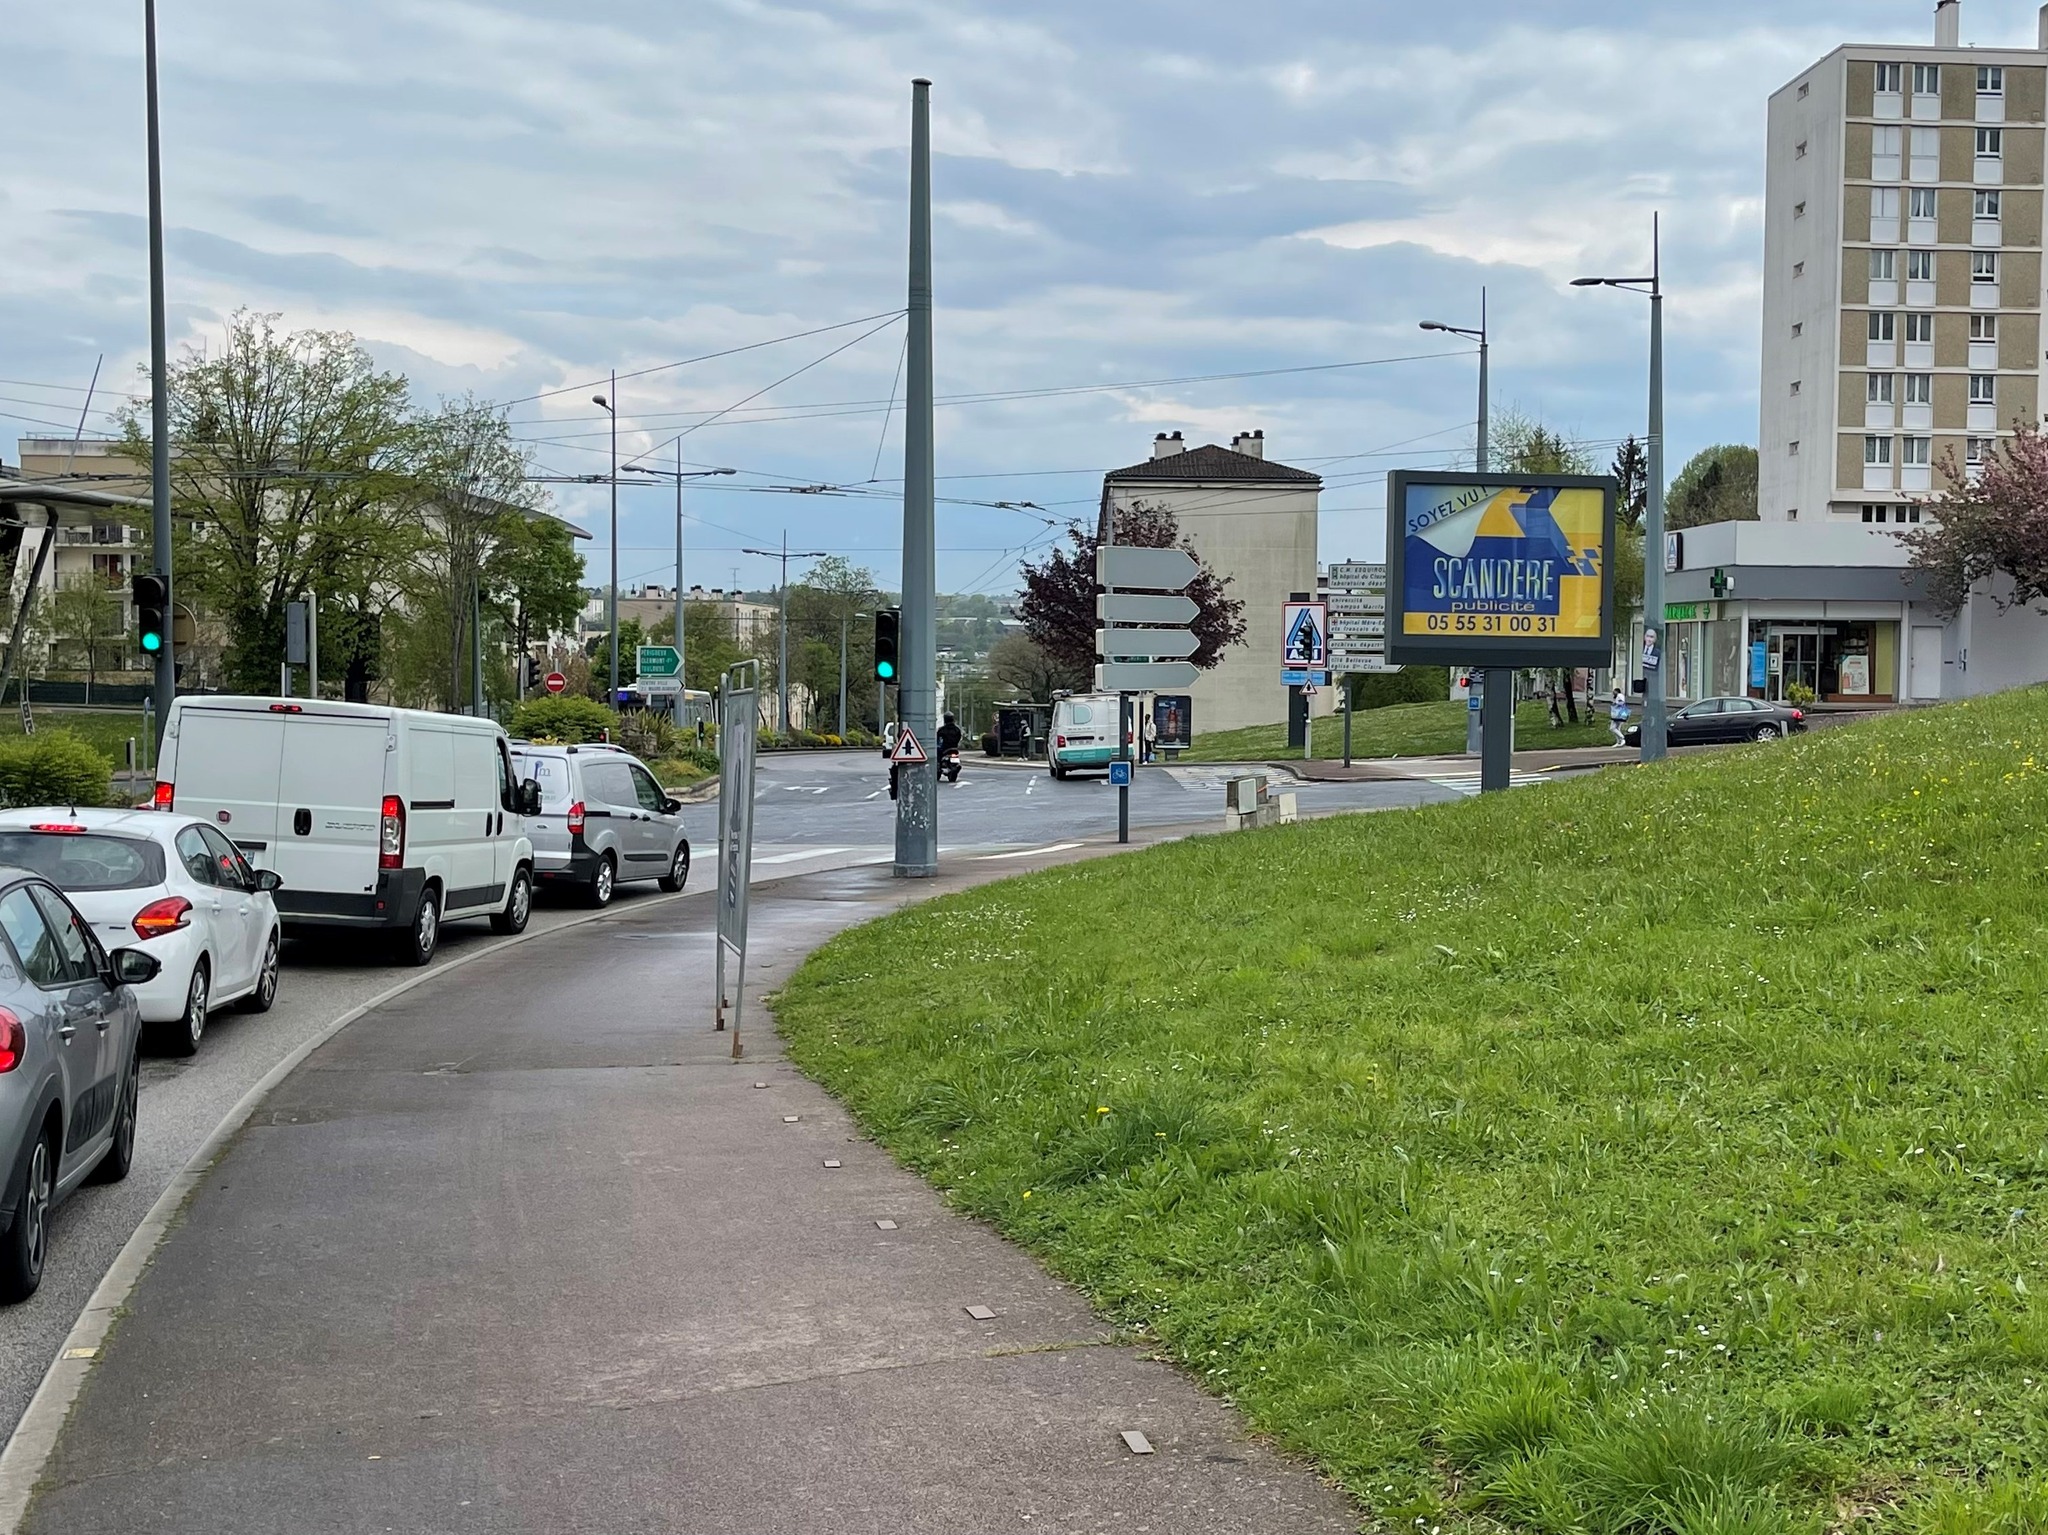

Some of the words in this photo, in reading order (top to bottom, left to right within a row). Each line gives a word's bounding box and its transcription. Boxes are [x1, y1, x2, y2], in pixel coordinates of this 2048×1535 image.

[1408, 500, 1456, 532] SOYEZ
[1456, 488, 1479, 508] VU
[1339, 573, 1360, 581] hôpital
[1433, 557, 1555, 601] SCANDERE
[1451, 599, 1536, 613] publicité
[1339, 619, 1360, 627] hôpital
[1427, 614, 1449, 631] 05
[1455, 615, 1477, 631] 55
[1482, 615, 1501, 632] 31
[1509, 616, 1531, 632] 00
[1537, 617, 1556, 633] 31
[1330, 663, 1350, 671] église
